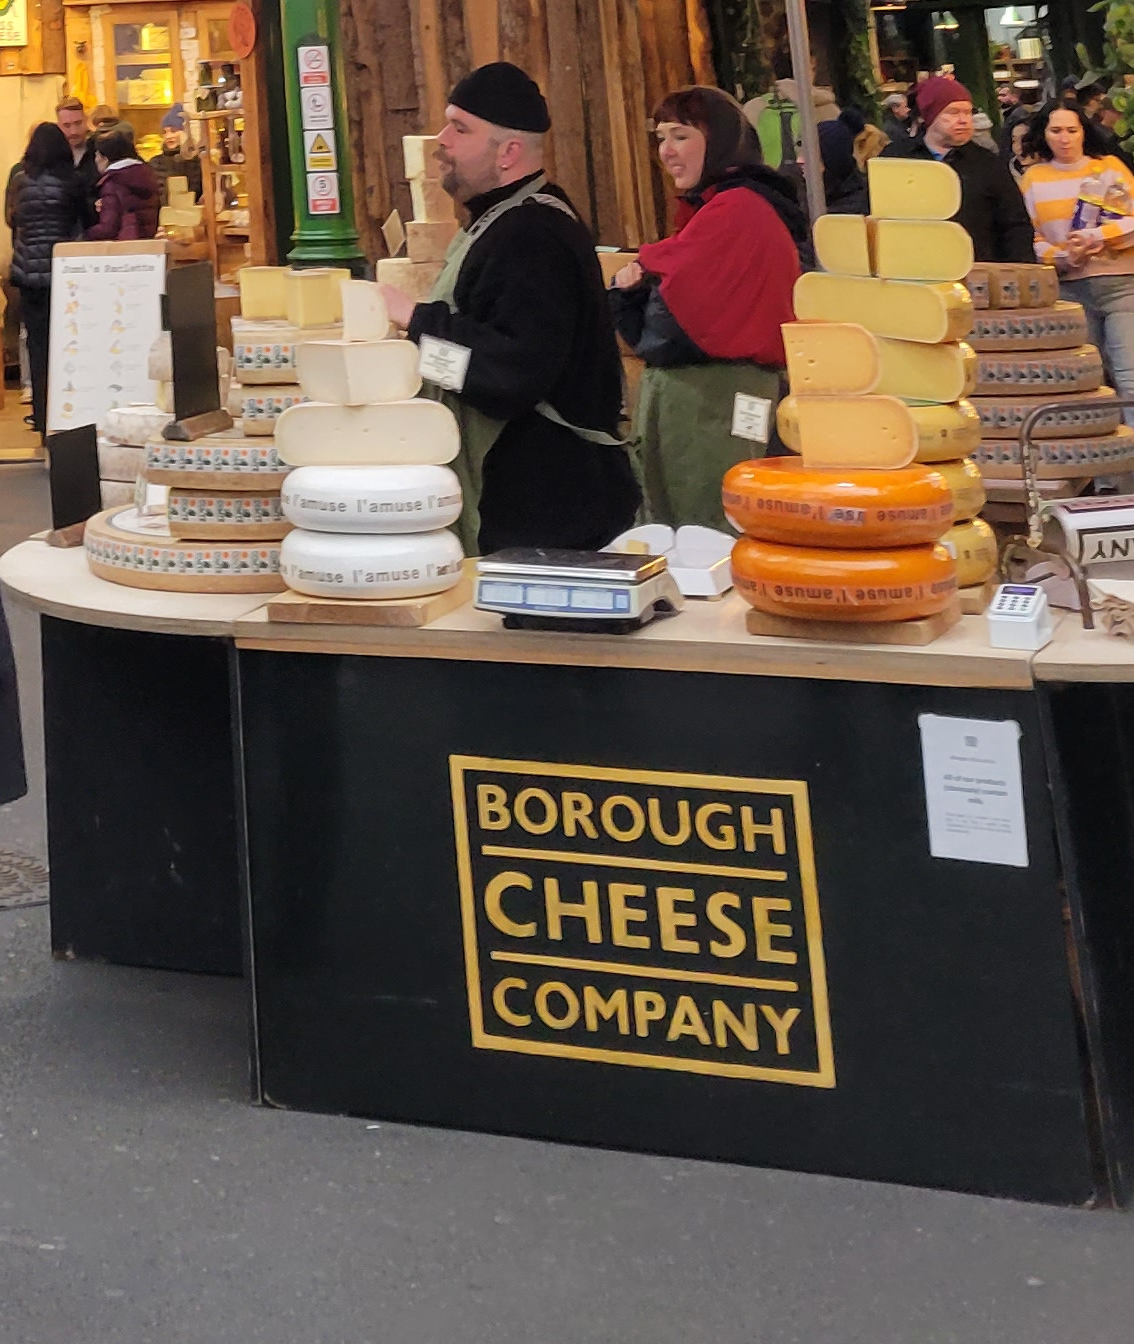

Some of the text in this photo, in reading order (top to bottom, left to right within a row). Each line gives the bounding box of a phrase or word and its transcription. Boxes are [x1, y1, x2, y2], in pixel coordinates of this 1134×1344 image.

[357, 499, 422, 513] l'amuse
[353, 568, 420, 583] l'amuse
[774, 585, 847, 603] l'amuse
[855, 585, 924, 601] l'amuse
[476, 784, 787, 855] BOROUGH
[484, 871, 798, 965] CHEESE
[492, 976, 801, 1055] COMPANY
